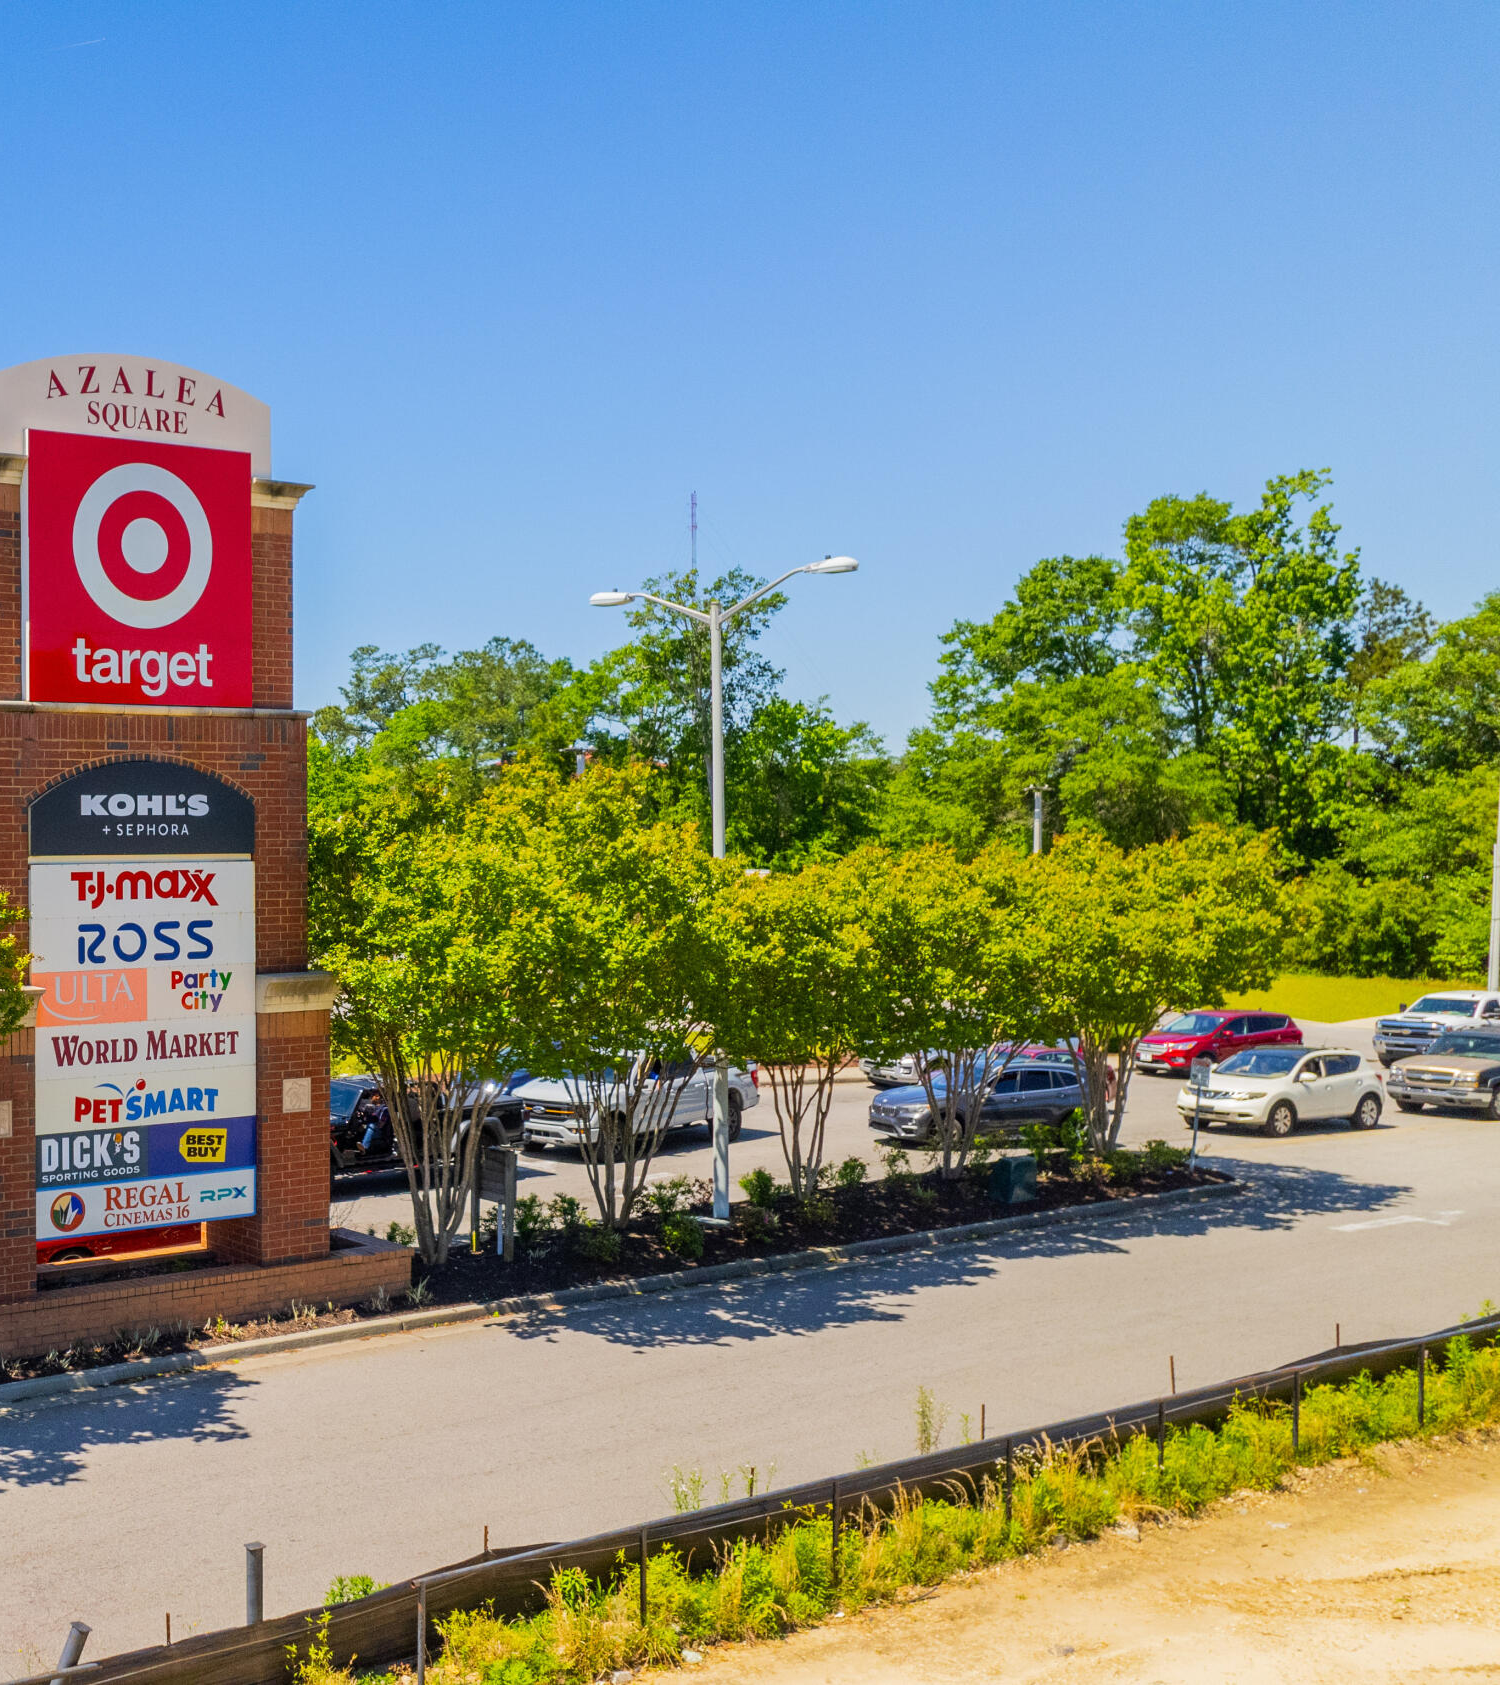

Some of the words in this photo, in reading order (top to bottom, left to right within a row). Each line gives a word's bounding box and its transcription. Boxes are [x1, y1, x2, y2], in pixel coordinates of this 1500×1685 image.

[46, 365, 226, 418] AZALEA
[87, 400, 188, 434] SQUARE
[72, 638, 213, 697] target
[80, 793, 210, 817] KOHL'S
[116, 823, 189, 836] SEPHORA
[78, 920, 214, 965] ROSS
[54, 972, 135, 1006] ULTA
[171, 969, 232, 990] Party
[181, 990, 223, 1013] City
[41, 1130, 140, 1173] DICK'S
[185, 1134, 225, 1146] BEST
[186, 1146, 220, 1158] BUY
[41, 1169, 99, 1184] SPORTING
[103, 1165, 140, 1177] GOODS
[200, 1186, 247, 1203] RPX
[104, 1207, 173, 1228] CINEMAS
[176, 1206, 190, 1219] 16
